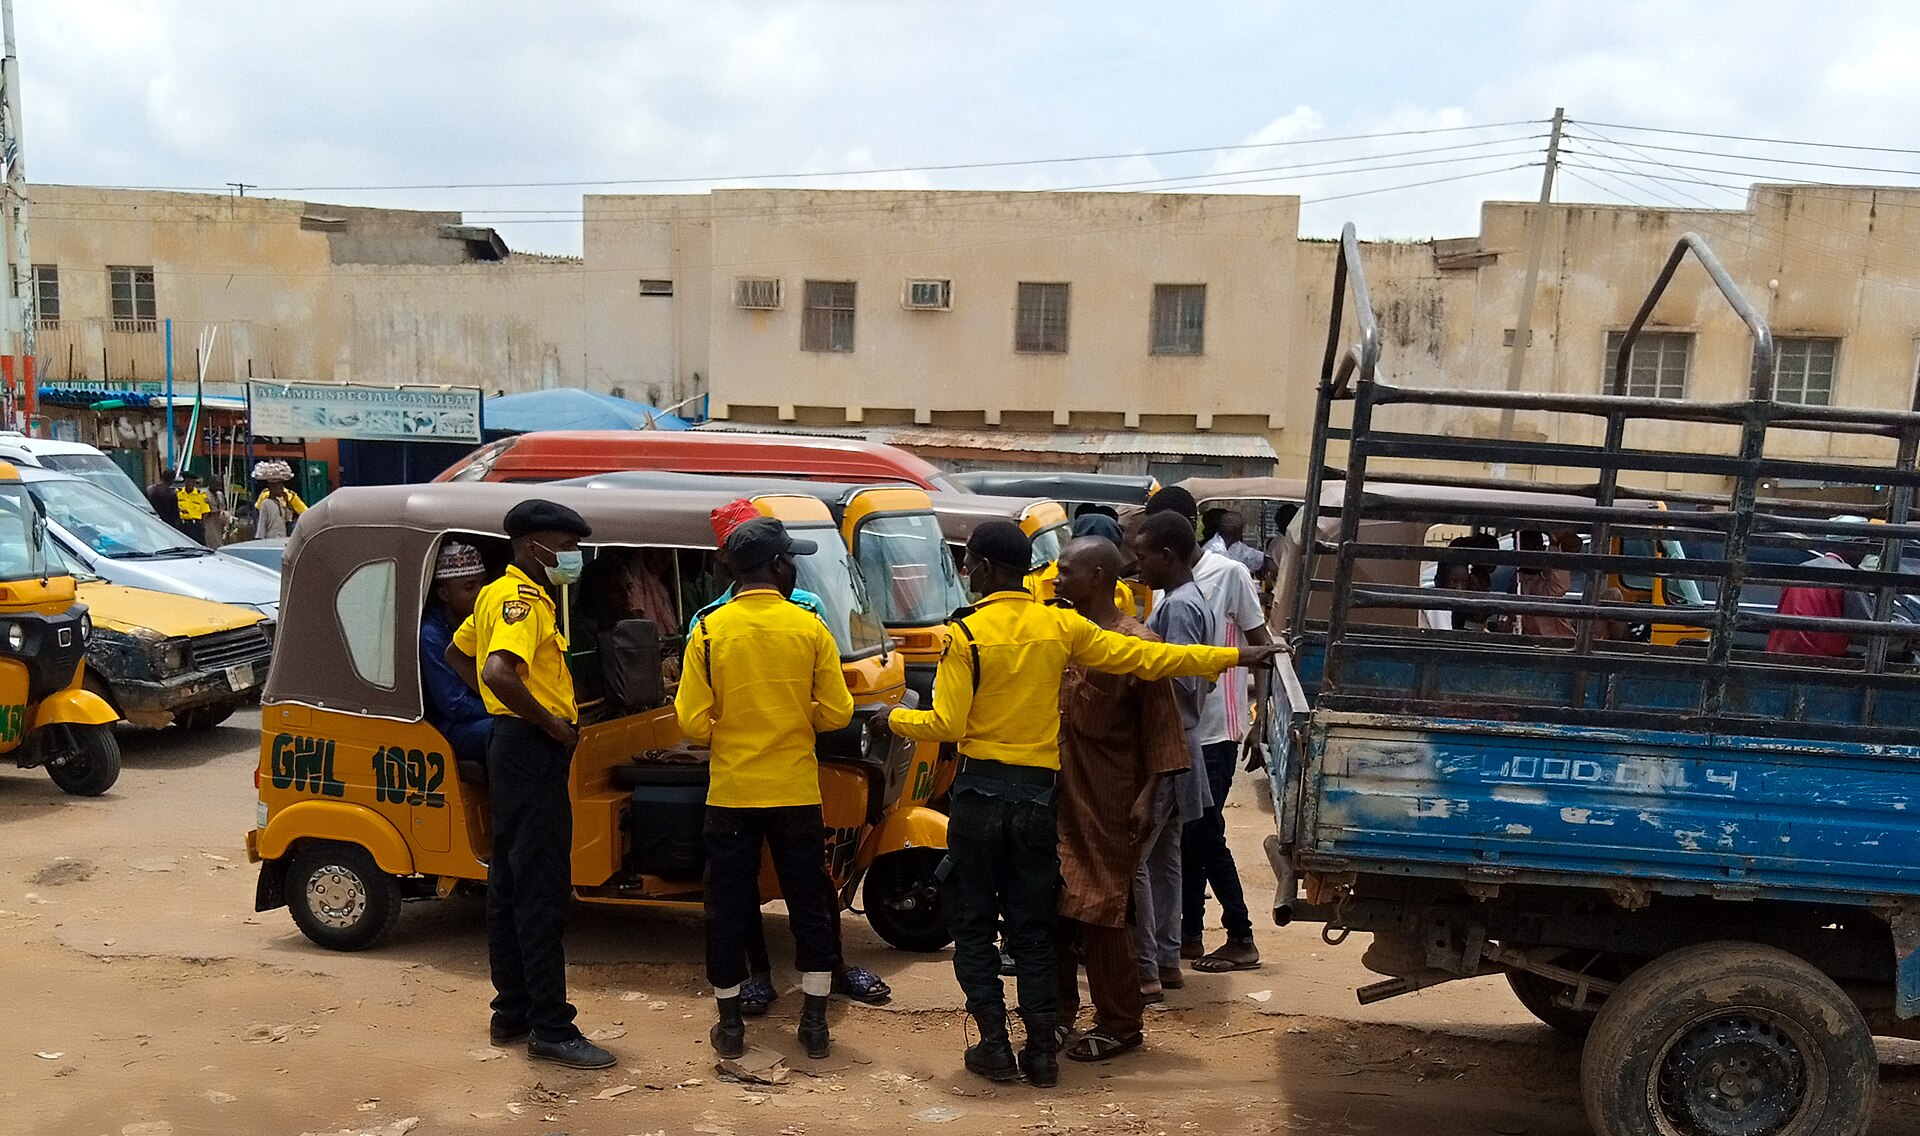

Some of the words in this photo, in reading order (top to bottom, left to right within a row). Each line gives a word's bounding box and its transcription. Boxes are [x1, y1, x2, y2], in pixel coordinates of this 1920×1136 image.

[327, 390, 391, 402] SPECIAL
[397, 392, 427, 402] GAS
[430, 394, 474, 404] MEAT
[372, 745, 445, 808] 1092
